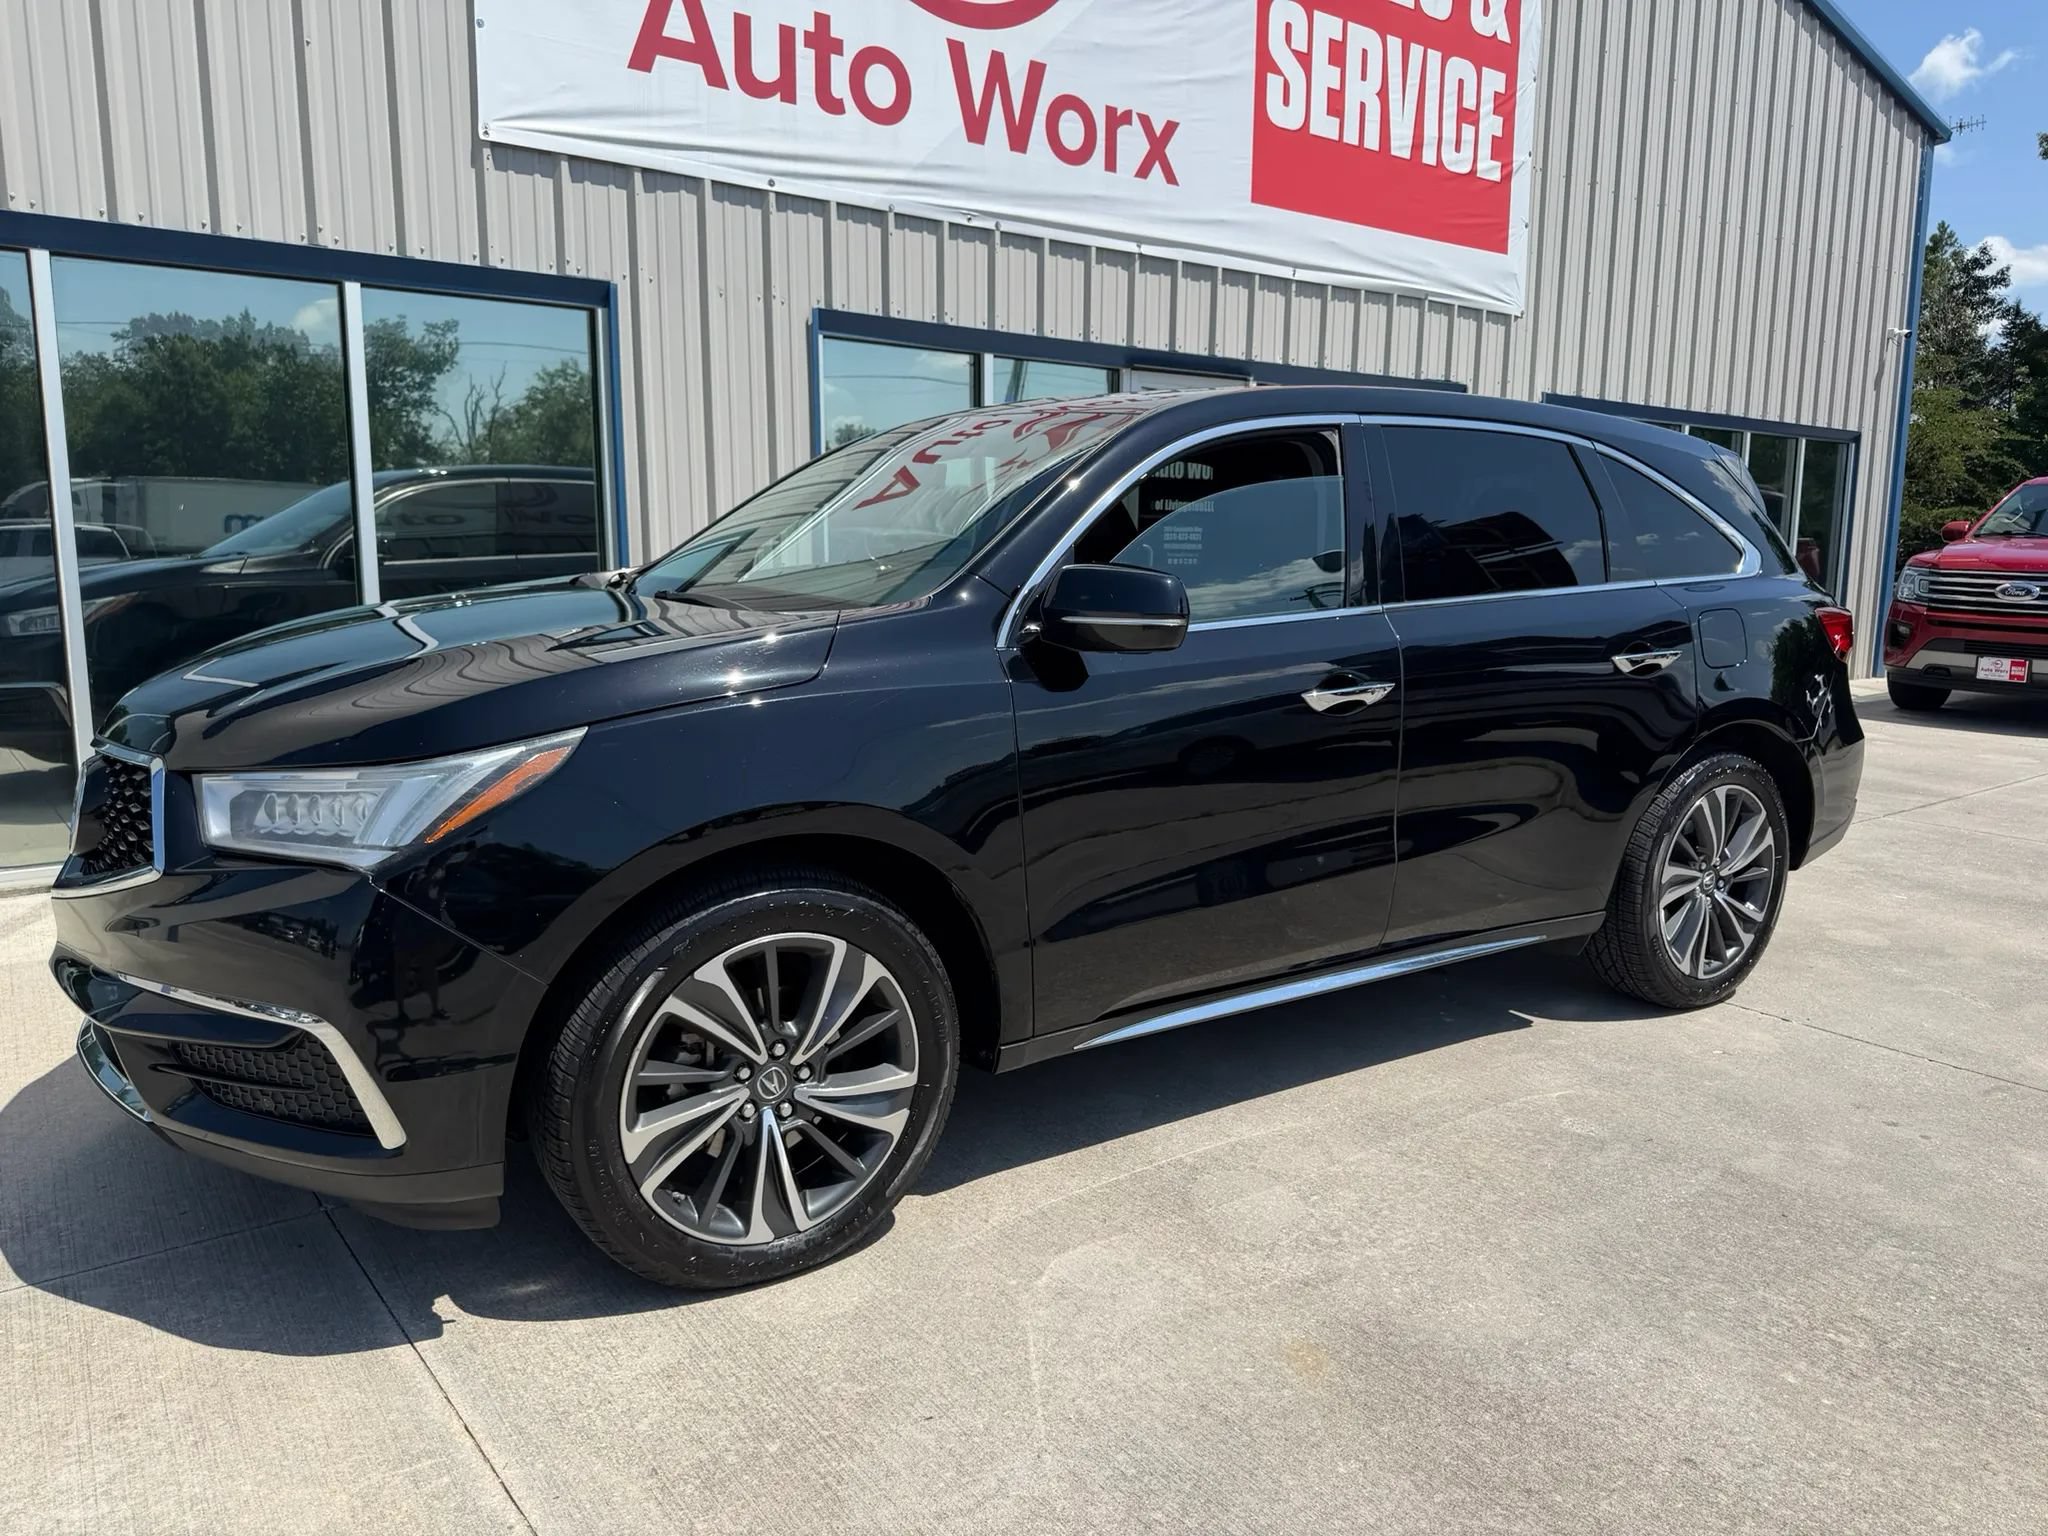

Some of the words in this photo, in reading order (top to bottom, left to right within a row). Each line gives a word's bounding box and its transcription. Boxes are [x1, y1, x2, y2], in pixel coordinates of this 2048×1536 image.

[628, 0, 911, 126] Auto
[946, 37, 1178, 186] Worx
[1265, 0, 1506, 182] SERVICE
[2005, 586, 2028, 596] Ford
